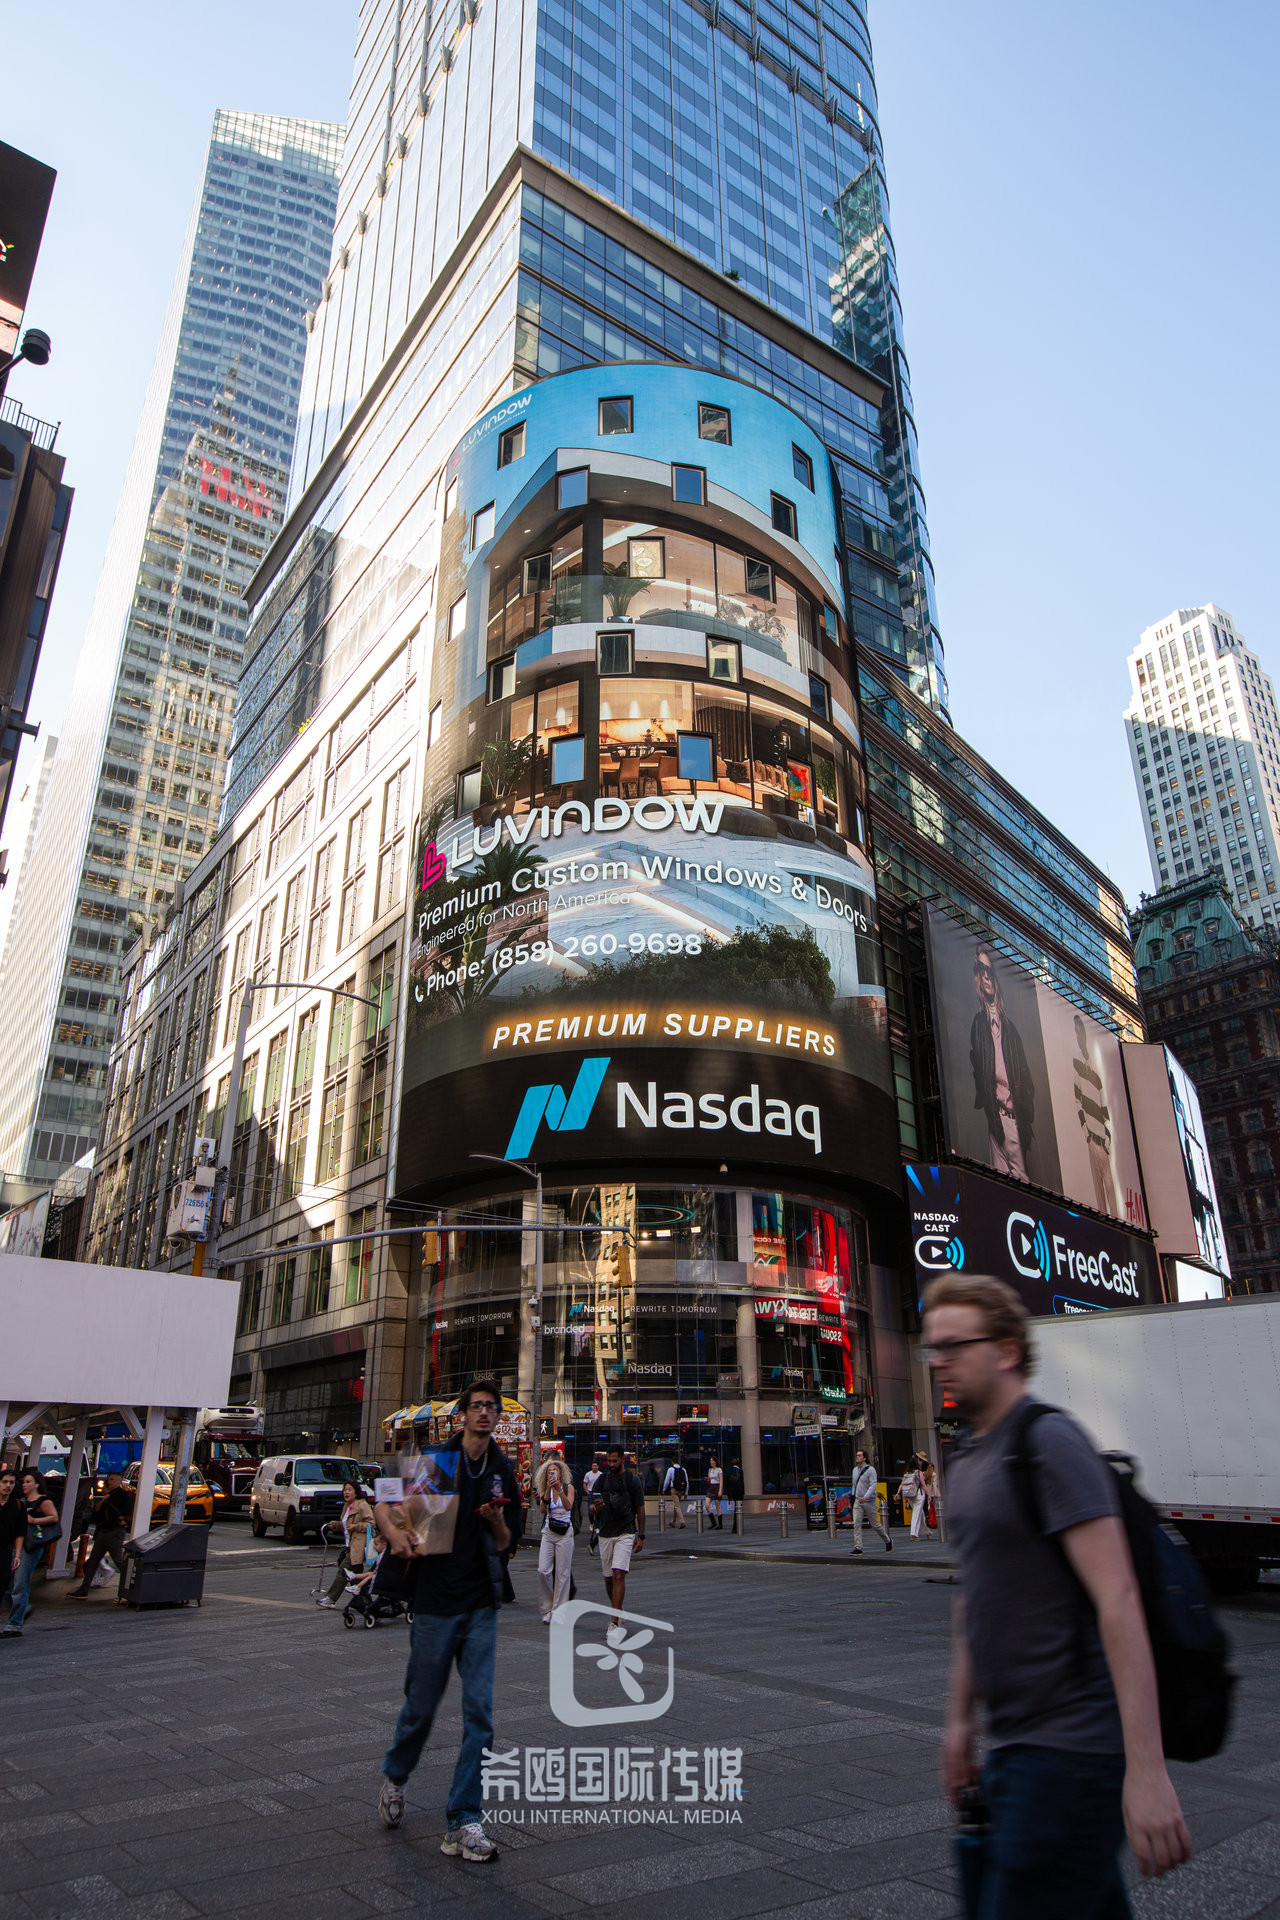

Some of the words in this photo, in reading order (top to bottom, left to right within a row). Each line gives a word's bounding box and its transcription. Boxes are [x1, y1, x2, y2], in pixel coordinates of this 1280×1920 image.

[450, 796, 725, 870] LUVINDOW
[418, 880, 501, 937] Premium
[511, 860, 629, 892] Custom
[640, 855, 782, 895] Windows
[791, 876, 808, 903] &
[815, 884, 867, 933] Doors
[416, 915, 475, 960] Engineered
[479, 909, 499, 928] for
[502, 898, 548, 920] North
[554, 892, 631, 908] America
[426, 957, 485, 996] Phone:
[492, 939, 554, 976] (858)
[563, 932, 702, 958] 260-9698
[492, 1013, 647, 1049] PREMIUM
[663, 1013, 836, 1056] SUPPLIERS
[616, 1081, 823, 1155] Nasdaq
[913, 1212, 959, 1224] NASDAQ:
[924, 1223, 950, 1233] CAST
[1052, 1234, 1139, 1298] FreeCast
[477, 1311, 513, 1322] TOMORROW
[544, 1324, 585, 1335] branded
[583, 1304, 615, 1315] Nasdaq
[630, 1305, 667, 1313] REWRITE
[671, 1305, 718, 1314] TOMORROW
[628, 1363, 673, 1377] Nasdaq
